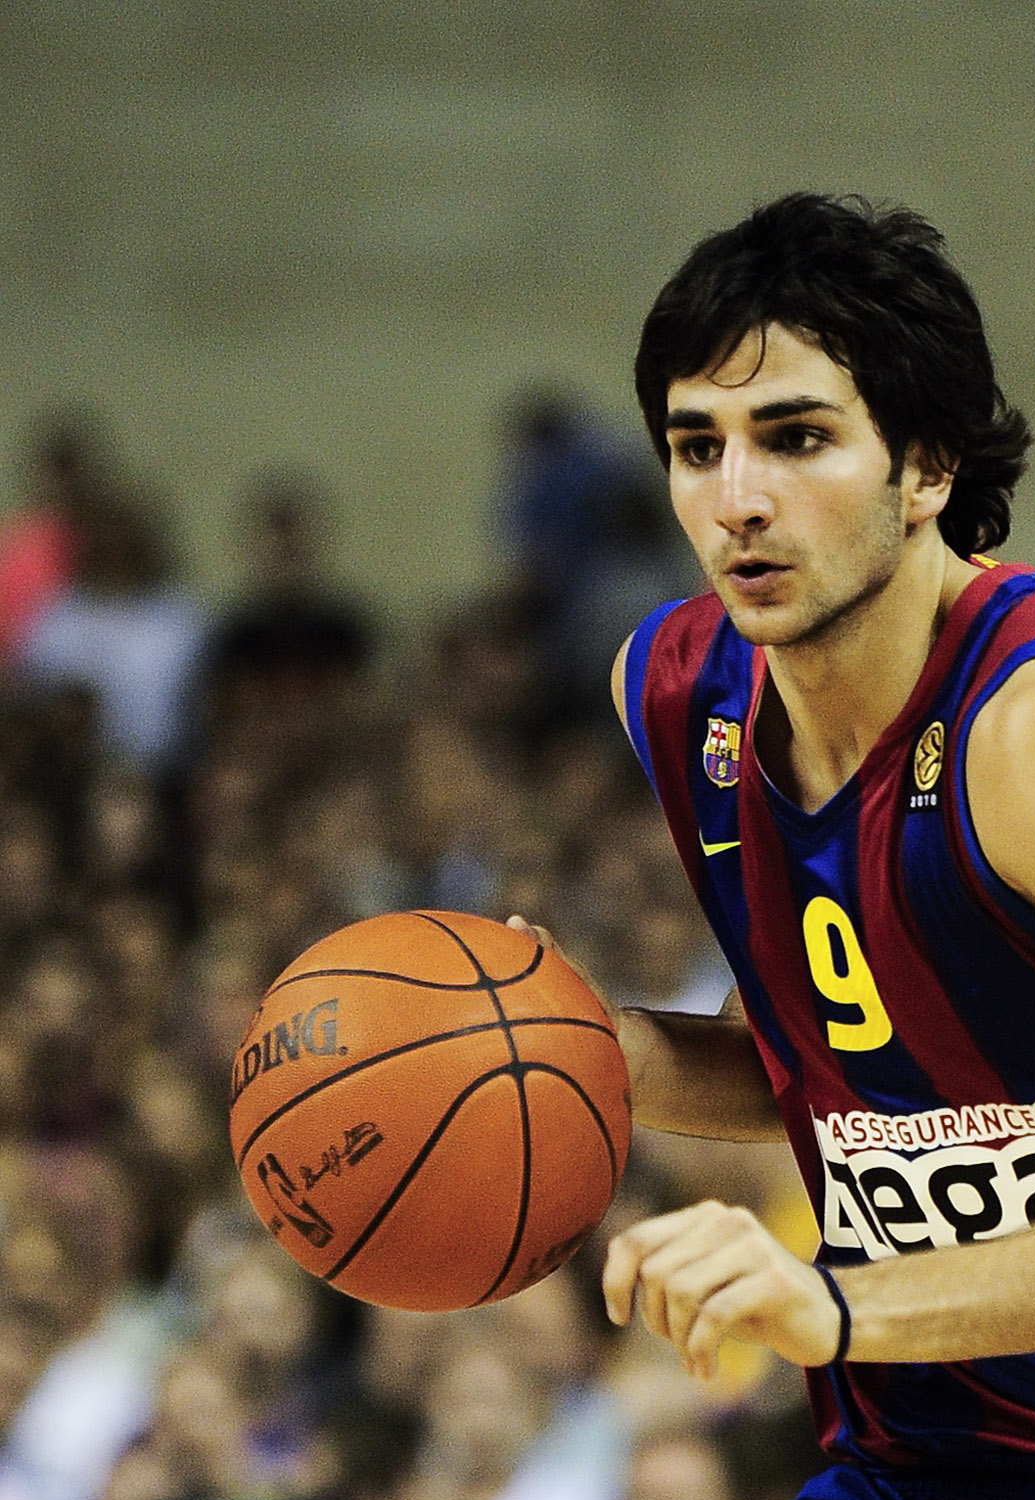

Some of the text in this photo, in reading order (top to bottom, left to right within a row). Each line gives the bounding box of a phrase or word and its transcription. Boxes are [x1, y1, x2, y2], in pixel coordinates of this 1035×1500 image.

[910, 794, 937, 808] 2010
[803, 897, 892, 1051] 9
[232, 998, 339, 1100] LDING
